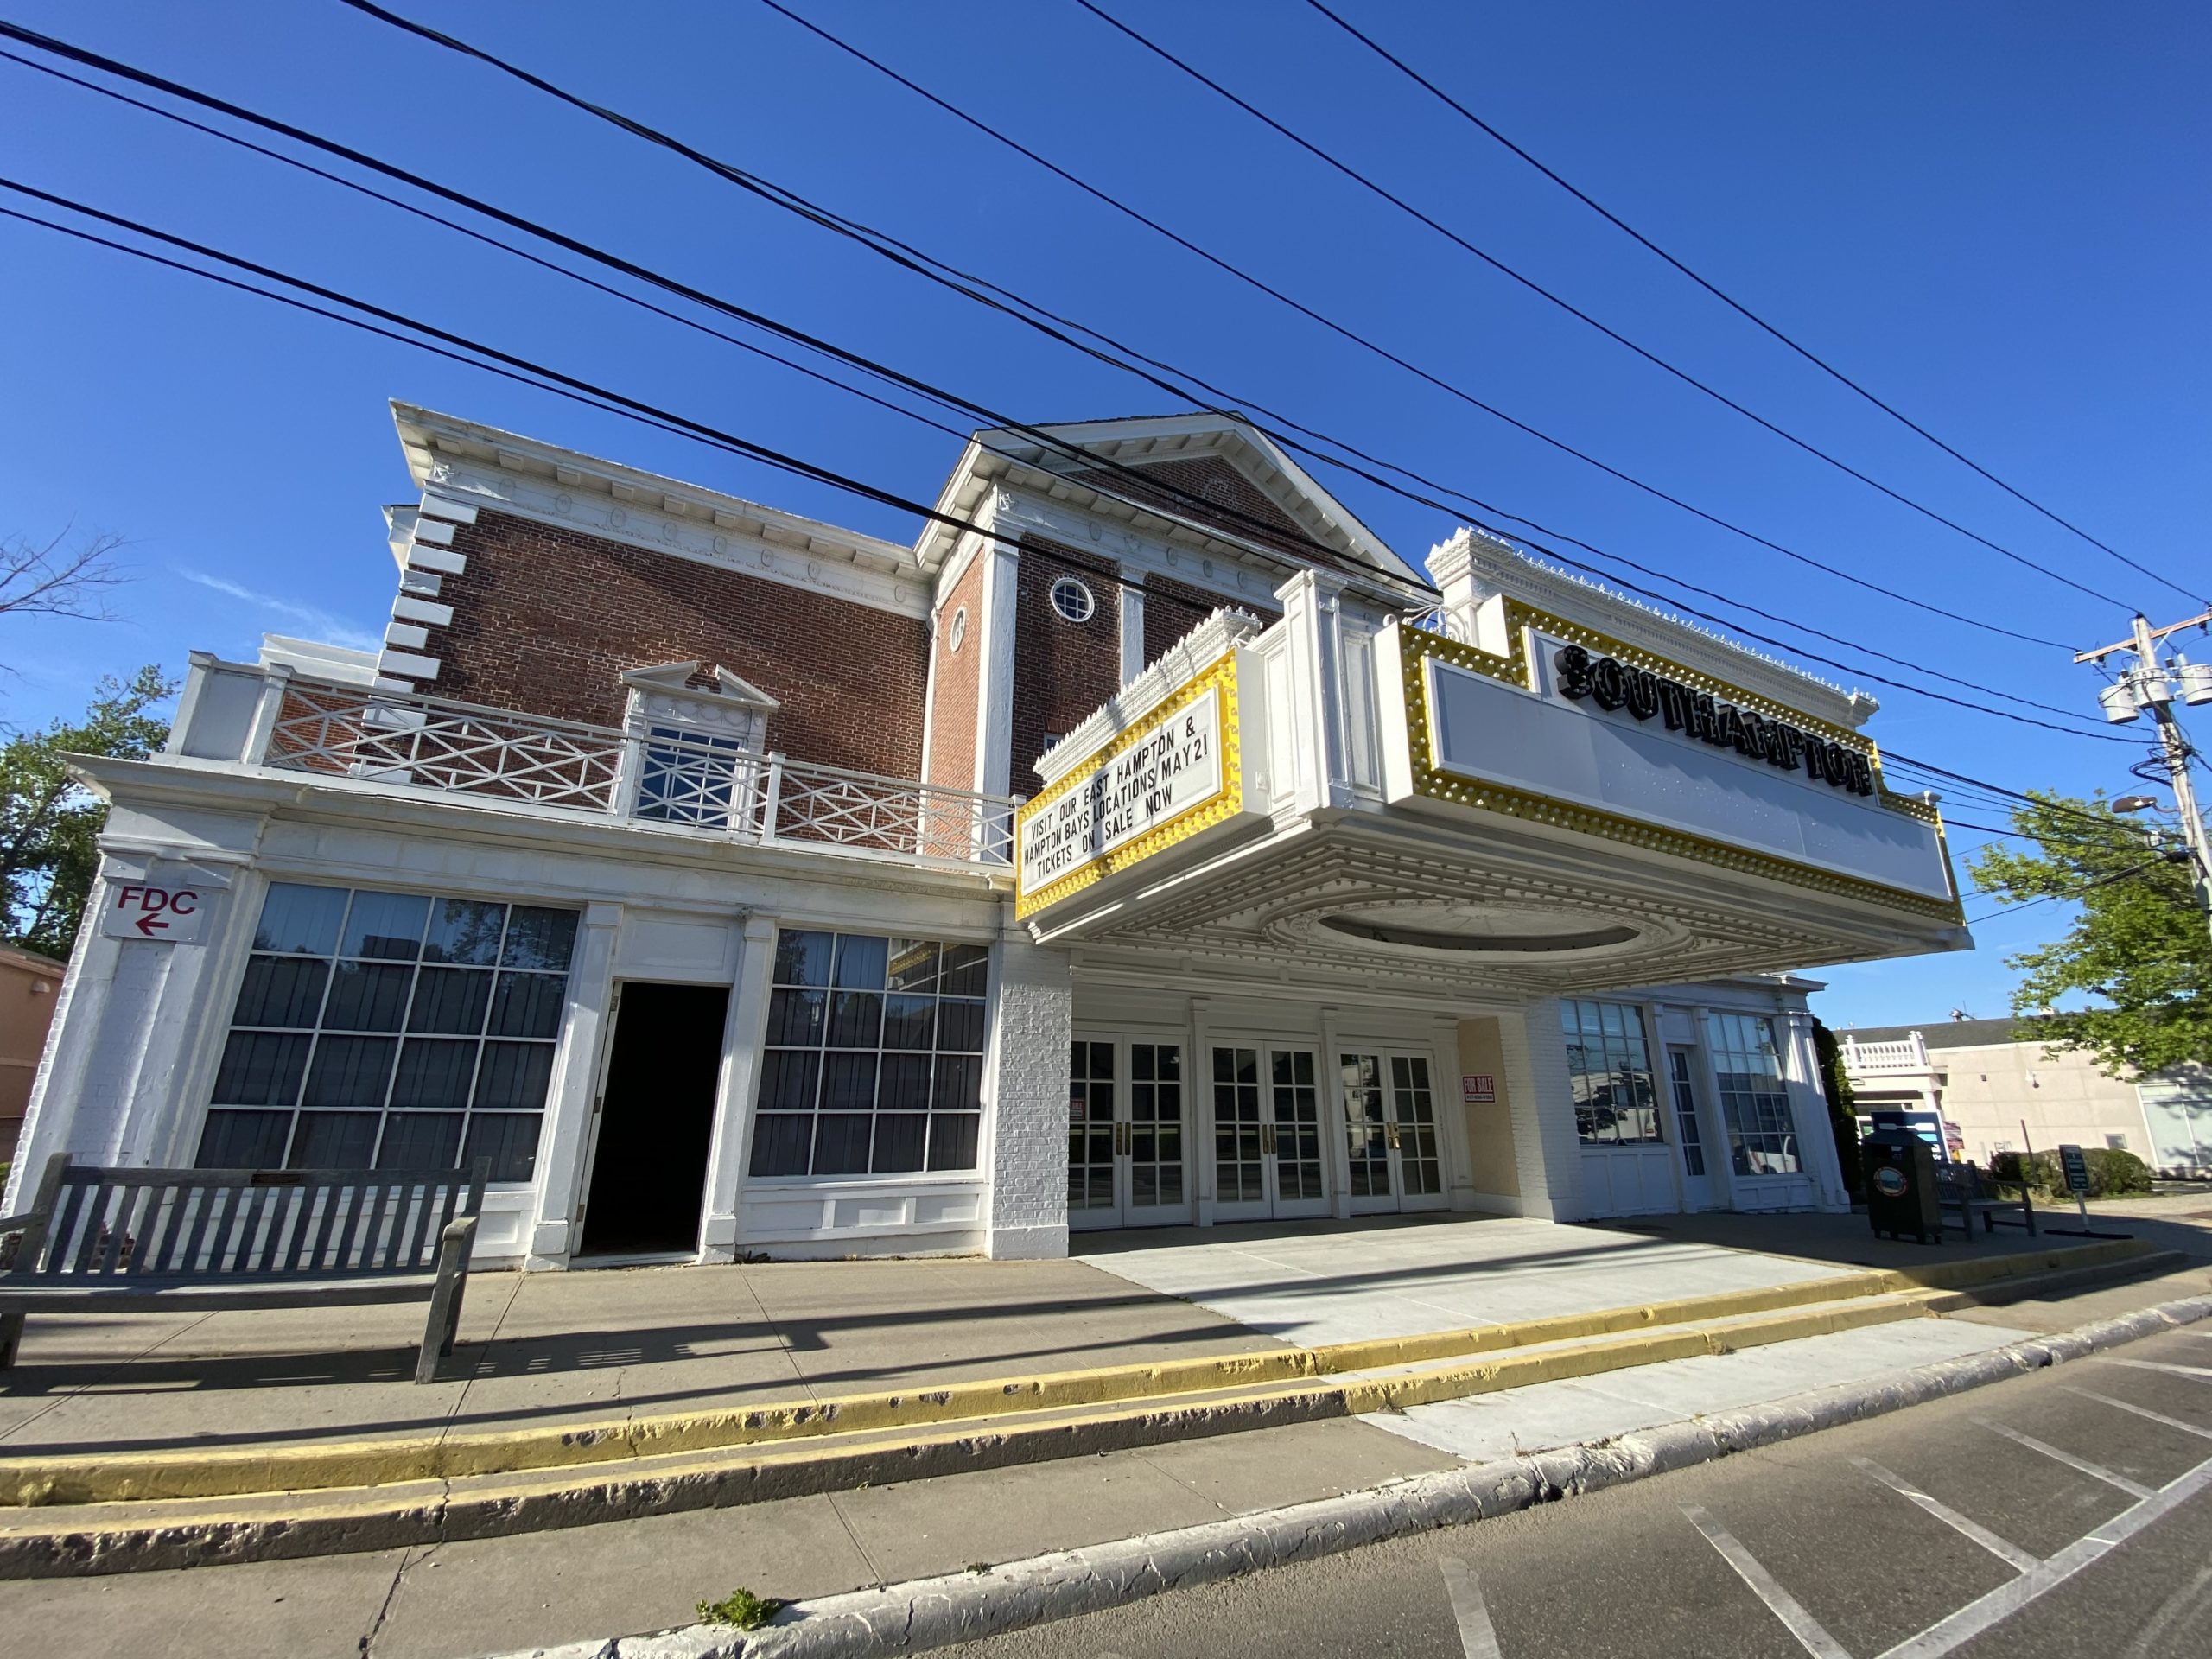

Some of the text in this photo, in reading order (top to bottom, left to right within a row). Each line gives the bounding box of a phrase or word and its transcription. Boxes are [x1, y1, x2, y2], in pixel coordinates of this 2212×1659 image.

[1554, 645, 1873, 796] SOUTHAMPTON
[1025, 734, 1207, 865] HAMPTON BAYS LOCATIONS MAY 21
[1032, 716, 1195, 840] VISIT OUR EAST HAMPTON &
[1038, 783, 1172, 878] TICKETS ON SALE NOW
[118, 886, 198, 915] FDC
[1464, 1077, 1493, 1093] FOR SALE
